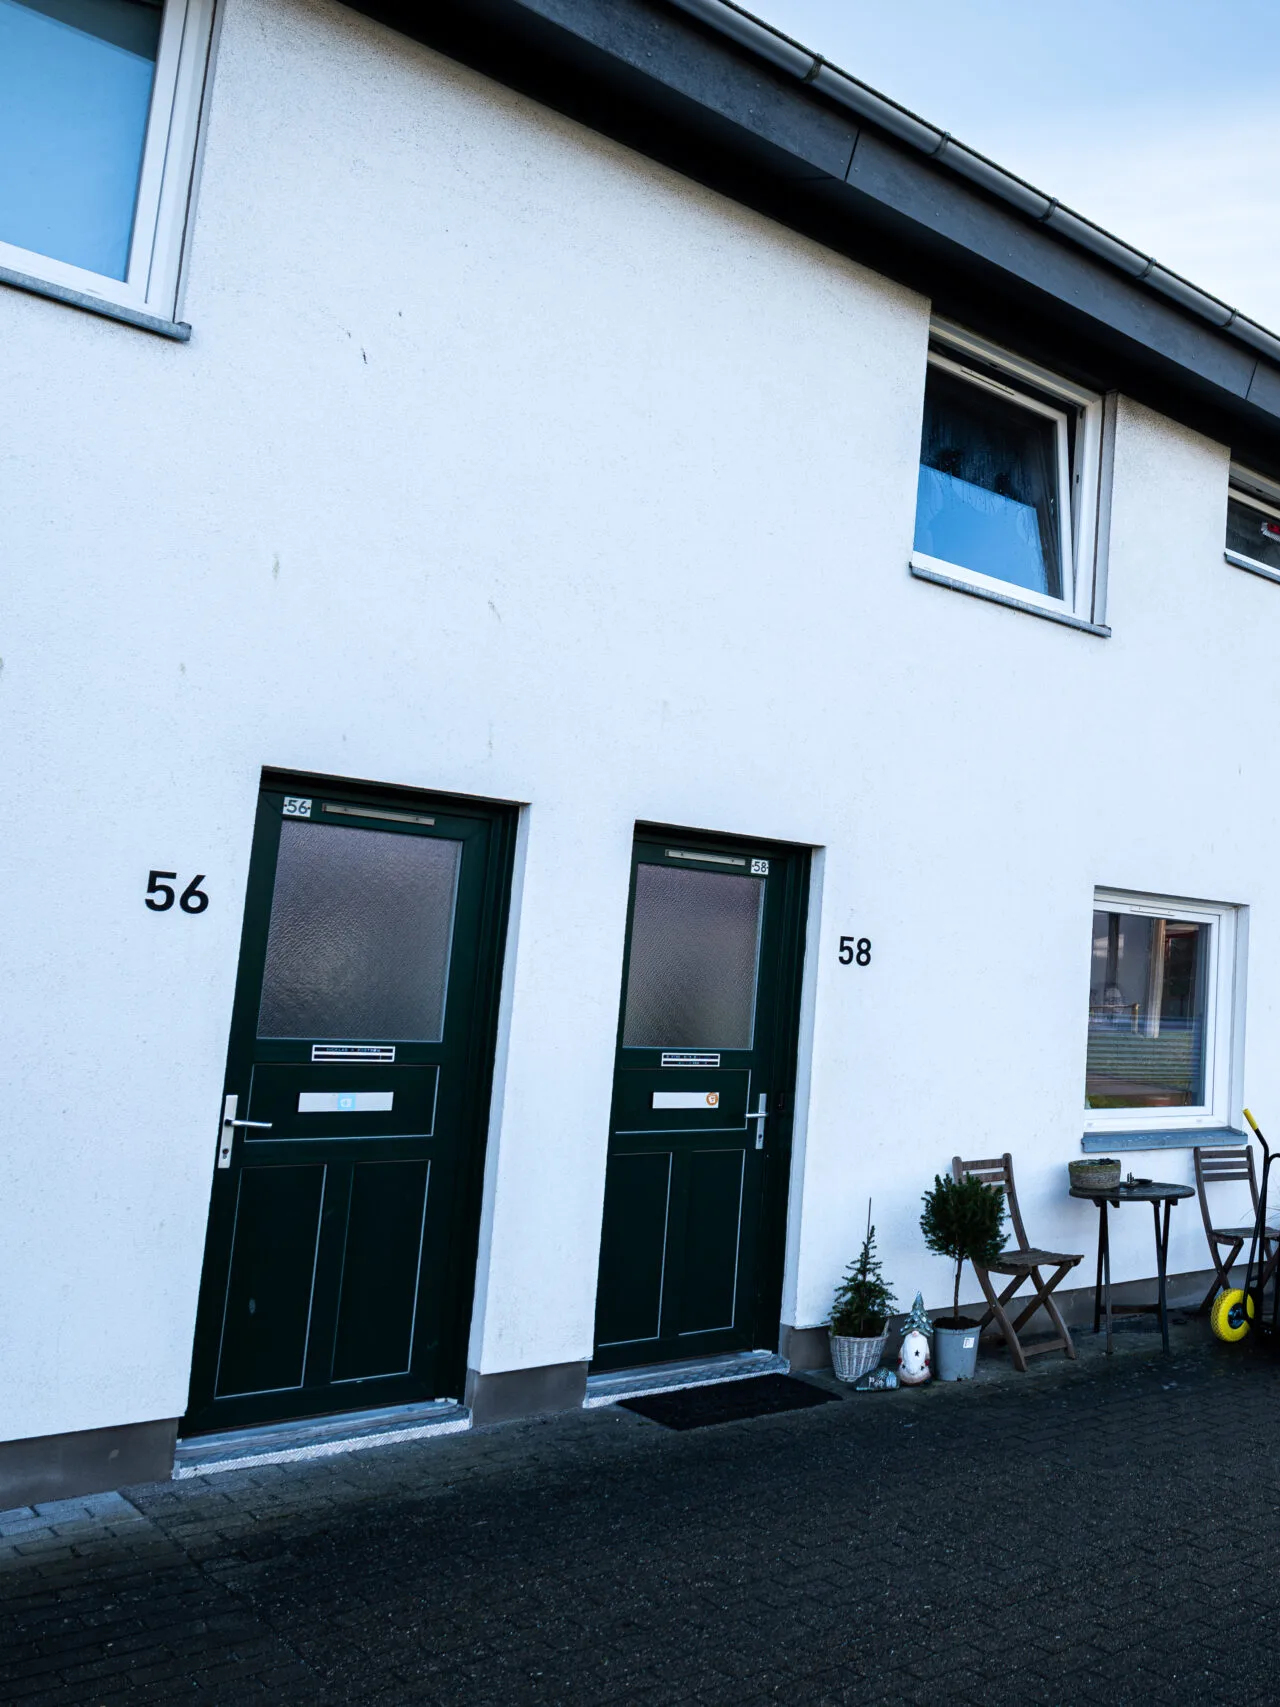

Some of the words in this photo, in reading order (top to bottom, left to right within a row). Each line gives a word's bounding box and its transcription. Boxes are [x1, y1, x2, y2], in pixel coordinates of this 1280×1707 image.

[286, 799, 308, 815] 56
[753, 861, 767, 873] 58
[144, 870, 209, 914] 56
[838, 935, 872, 967] 58
